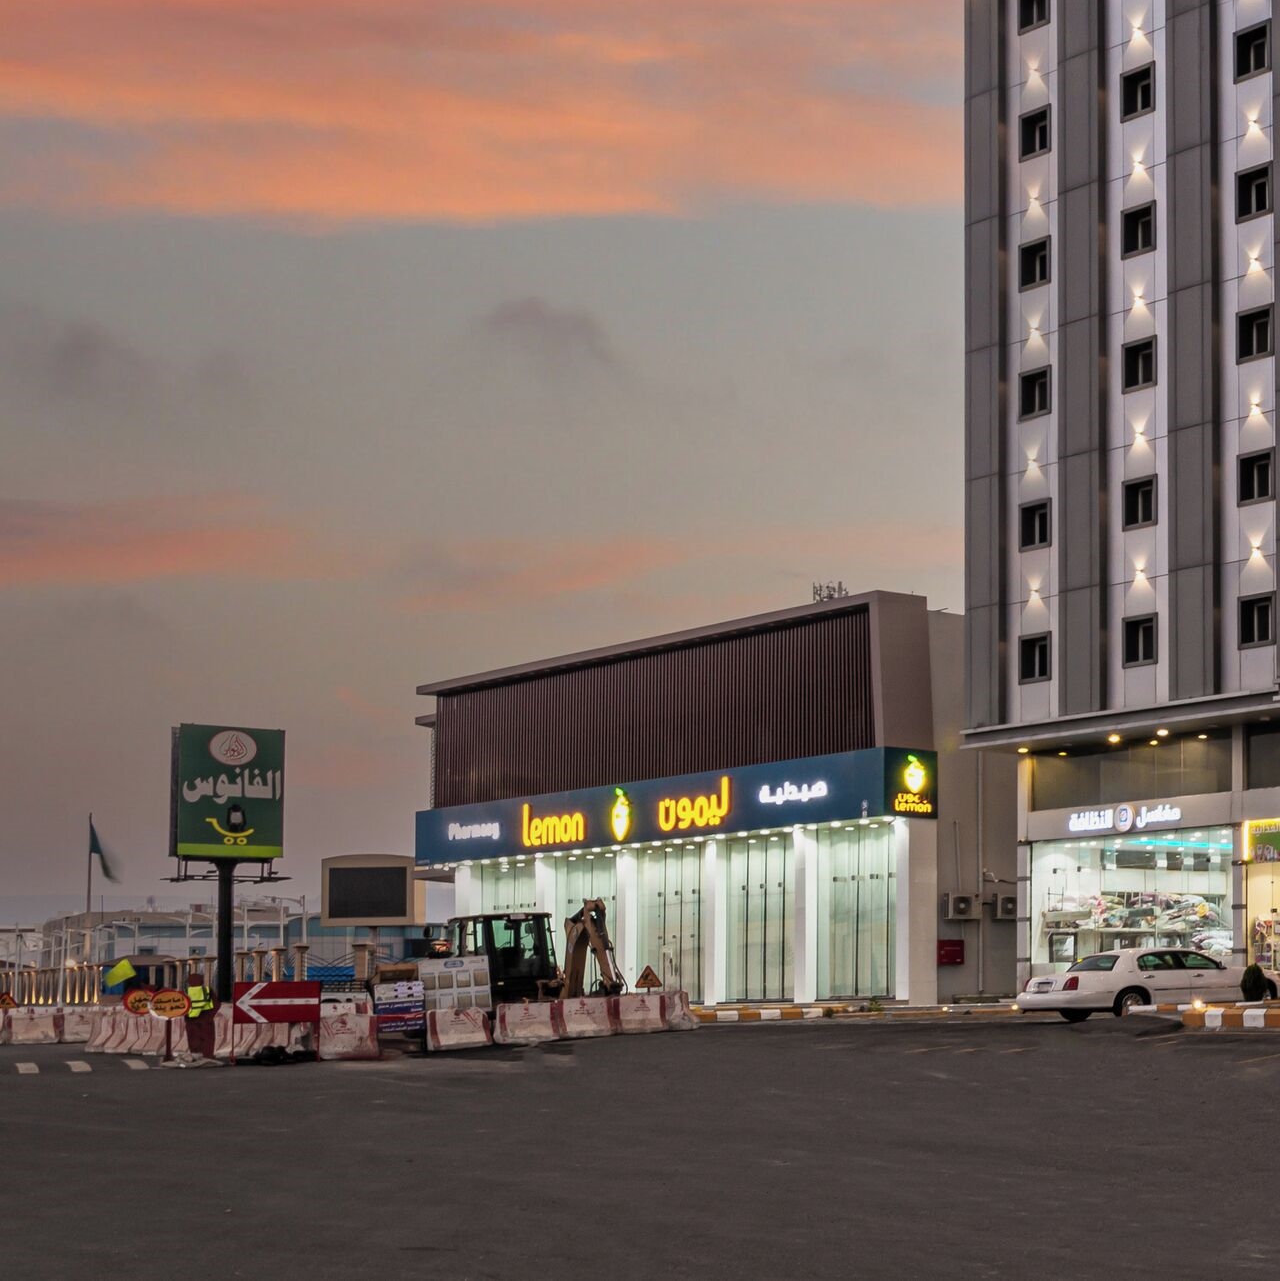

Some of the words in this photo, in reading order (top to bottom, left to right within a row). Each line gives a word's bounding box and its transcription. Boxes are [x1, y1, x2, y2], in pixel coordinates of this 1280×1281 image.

[182, 767, 282, 805] الفانوس
[658, 775, 729, 832] ليمون
[448, 821, 501, 841] Pharmacy
